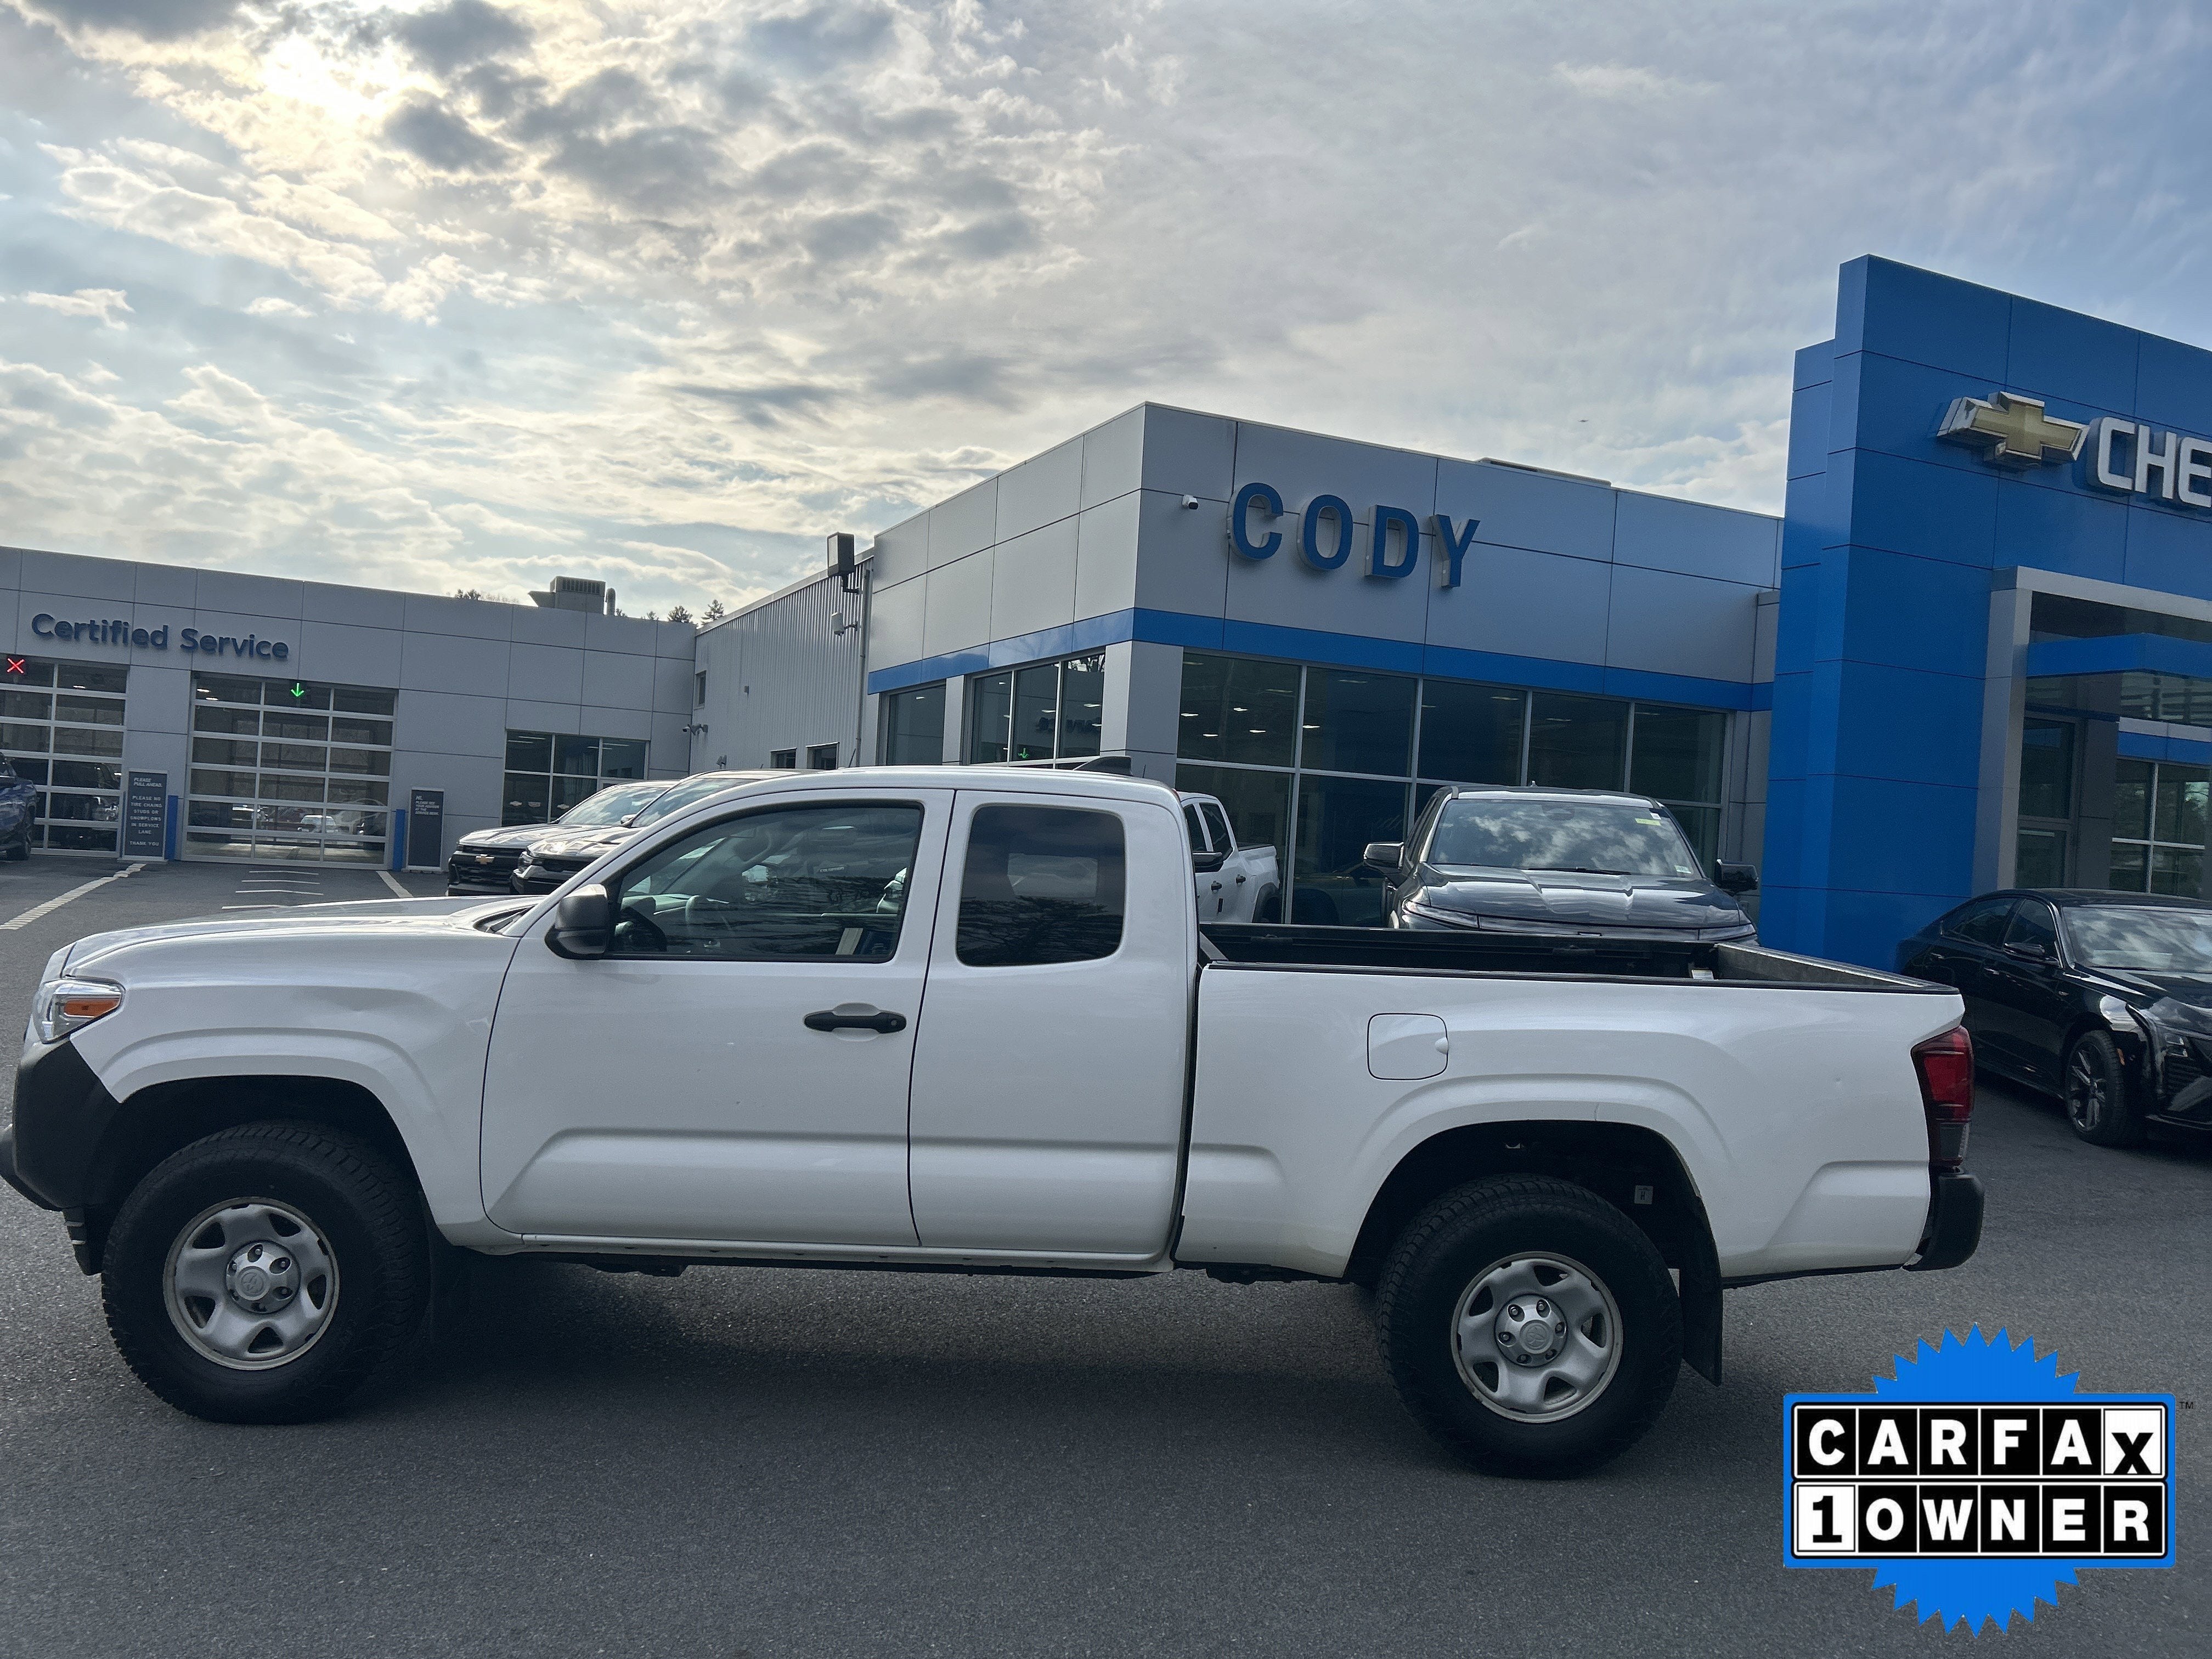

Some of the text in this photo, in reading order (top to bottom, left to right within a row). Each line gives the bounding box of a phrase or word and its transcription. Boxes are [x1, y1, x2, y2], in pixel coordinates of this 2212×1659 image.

[1227, 482, 1480, 588] CODY
[31, 613, 289, 659] Certified Service
